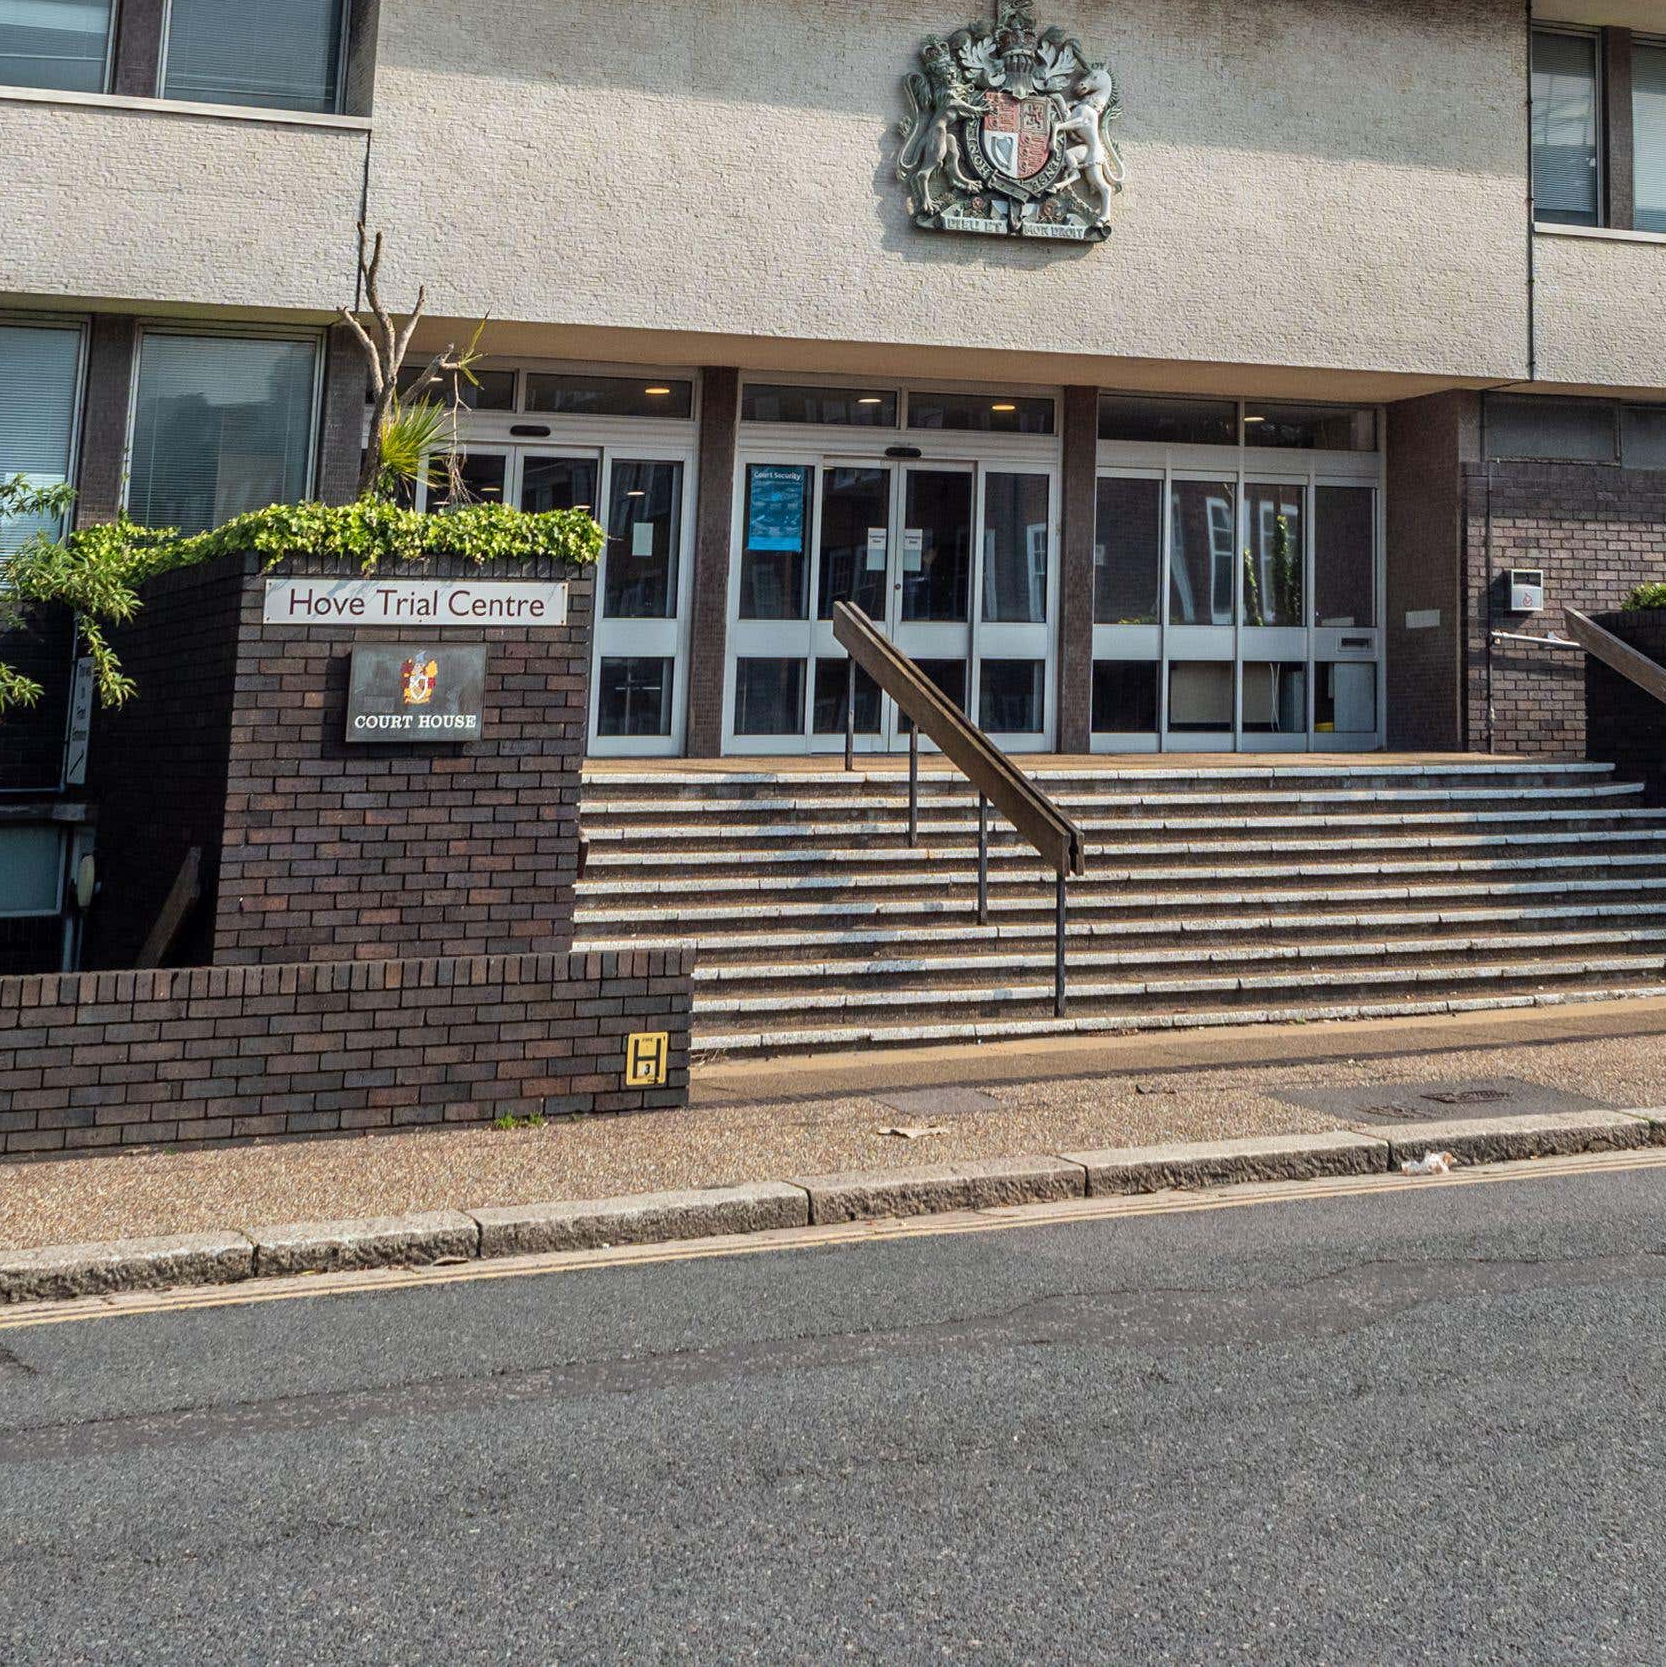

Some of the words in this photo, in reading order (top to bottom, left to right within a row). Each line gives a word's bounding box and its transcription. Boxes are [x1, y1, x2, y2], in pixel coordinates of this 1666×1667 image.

[754, 471, 773, 479] Court
[774, 472, 802, 481] Security
[289, 588, 365, 616] Hove
[376, 589, 438, 616] Trial
[448, 590, 545, 618] Centre
[354, 715, 413, 729] COURT
[418, 715, 477, 729] HOUSE
[632, 1038, 662, 1079] H
